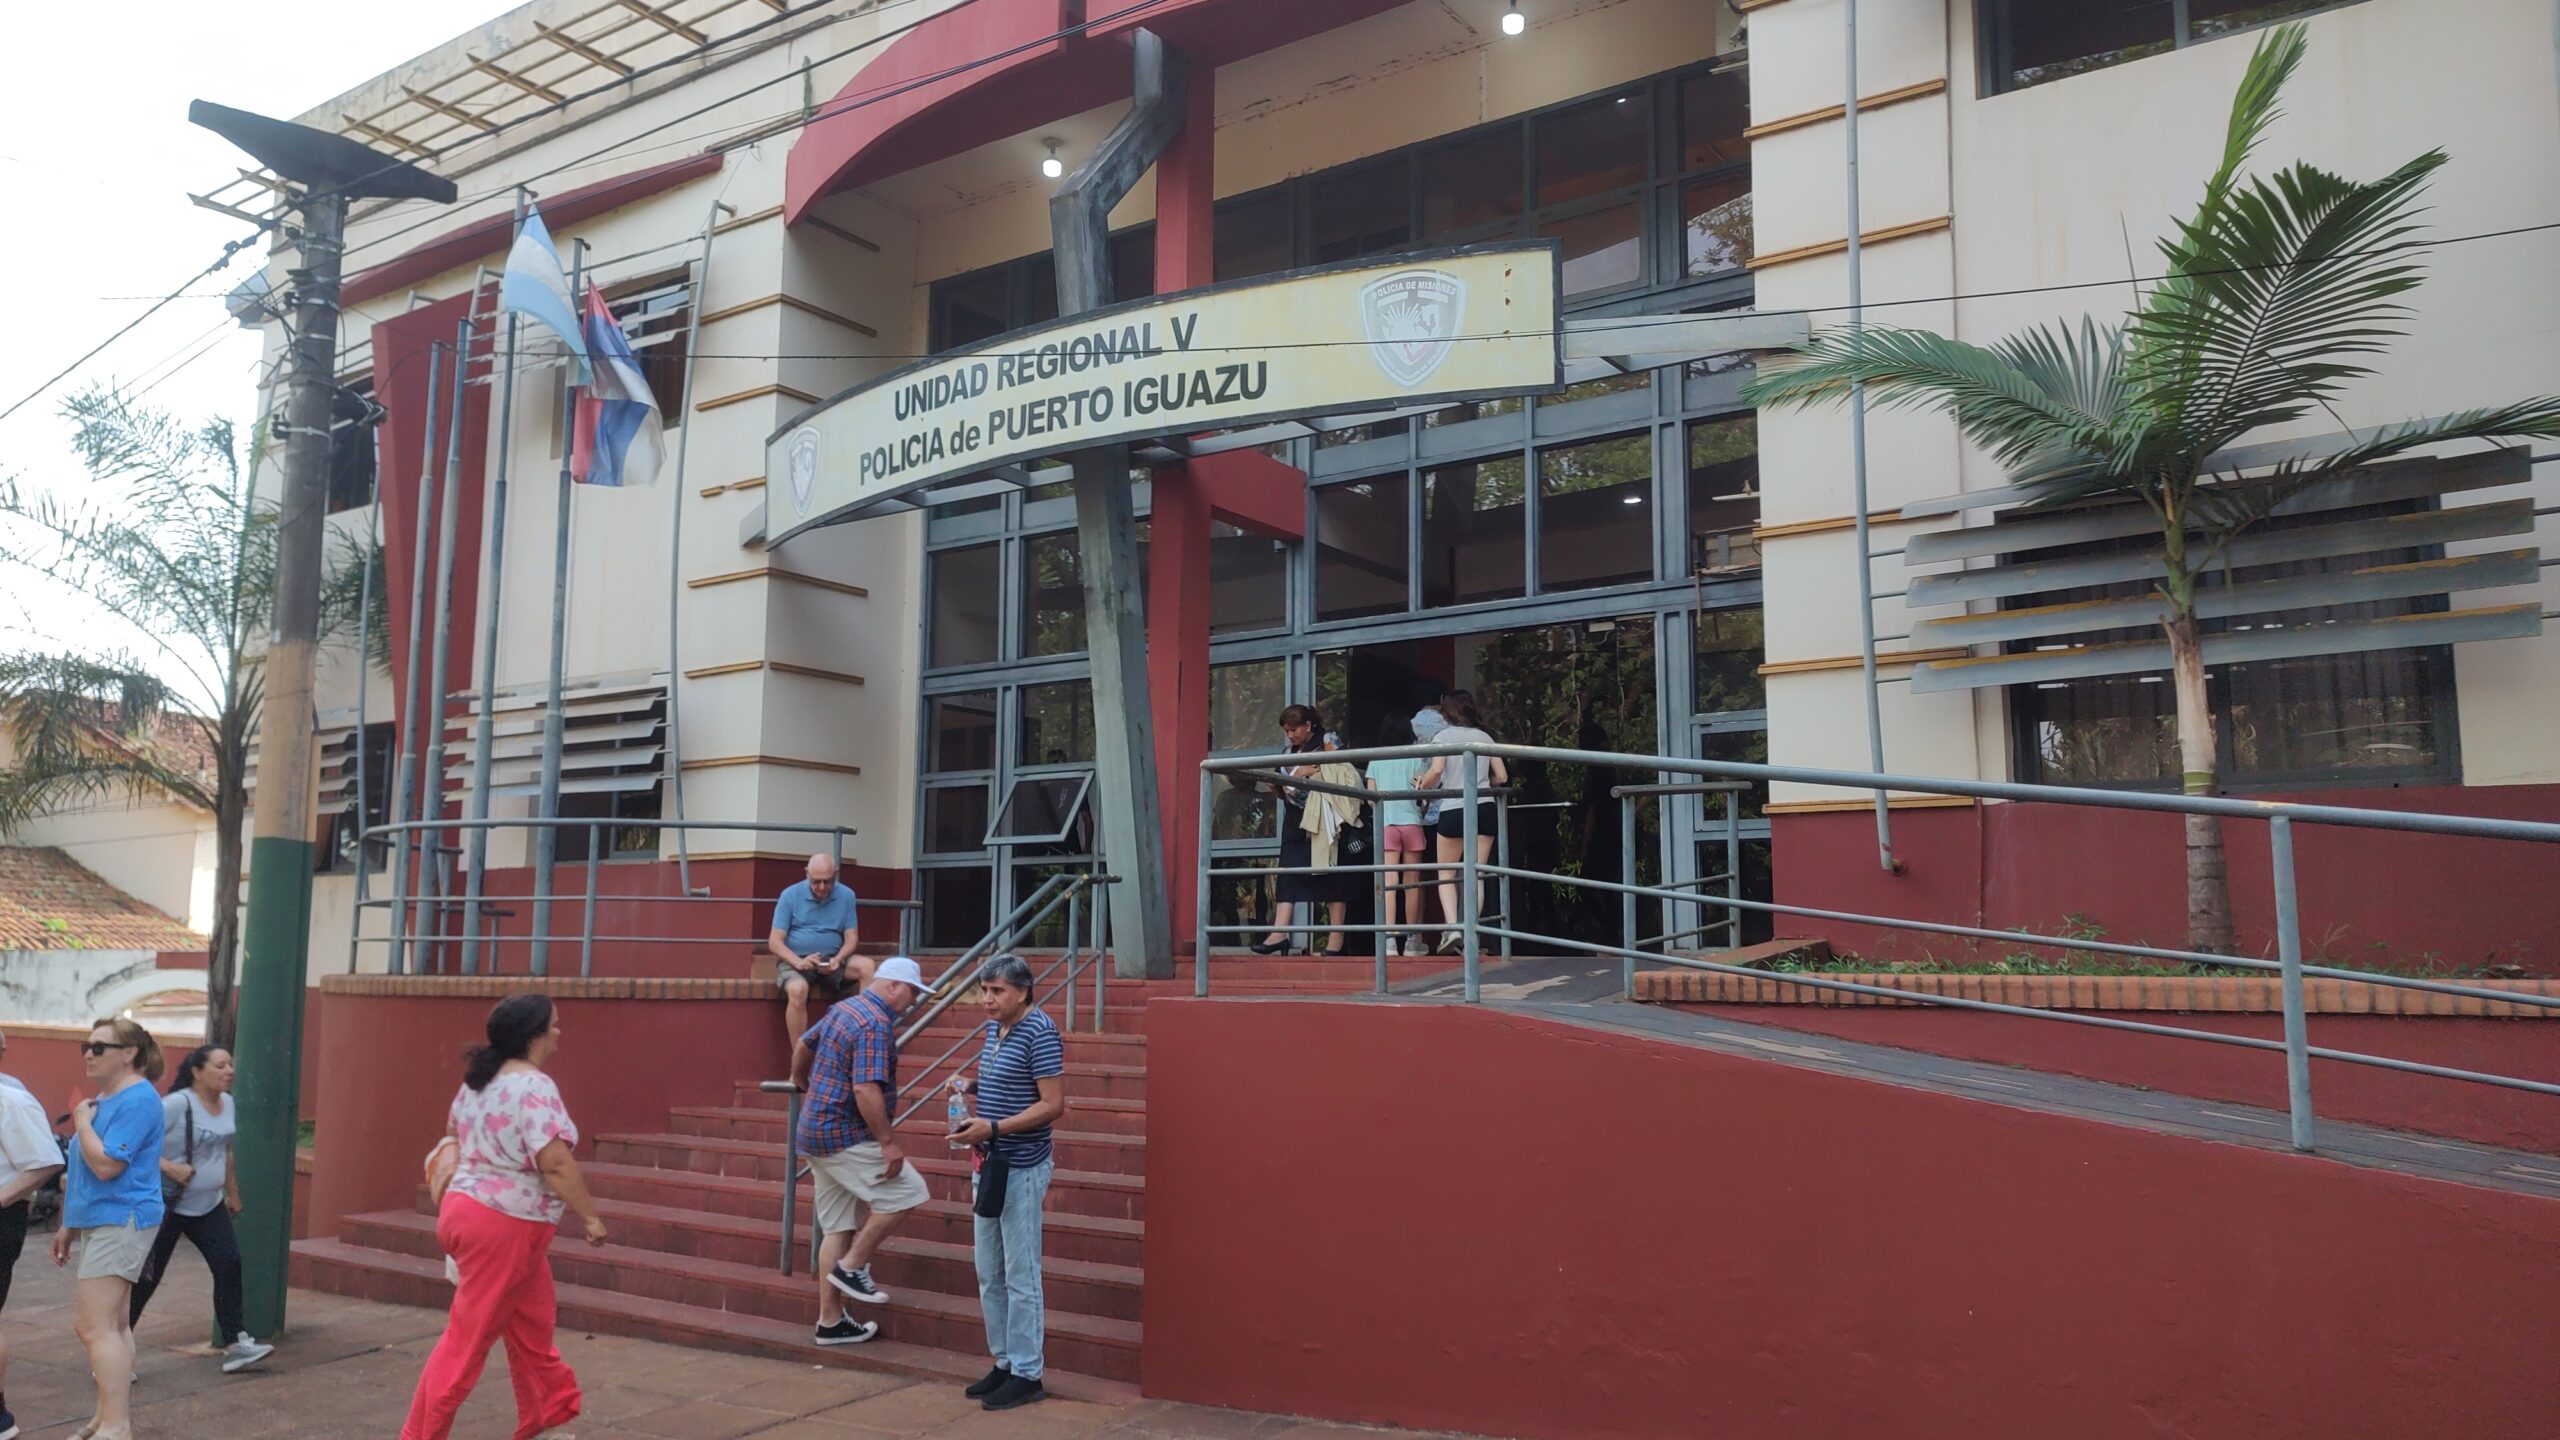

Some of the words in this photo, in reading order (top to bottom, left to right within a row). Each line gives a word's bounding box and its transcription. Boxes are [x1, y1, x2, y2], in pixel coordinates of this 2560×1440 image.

[1406, 281, 1416, 290] DE
[895, 362, 988, 421] UNIDAD
[997, 322, 1163, 391] REGIONAL
[1170, 313, 1198, 351] V
[860, 427, 945, 486] POLICIA
[950, 419, 981, 456] de
[988, 386, 1114, 445] PUERTO
[1124, 360, 1268, 418] IGUAZU
